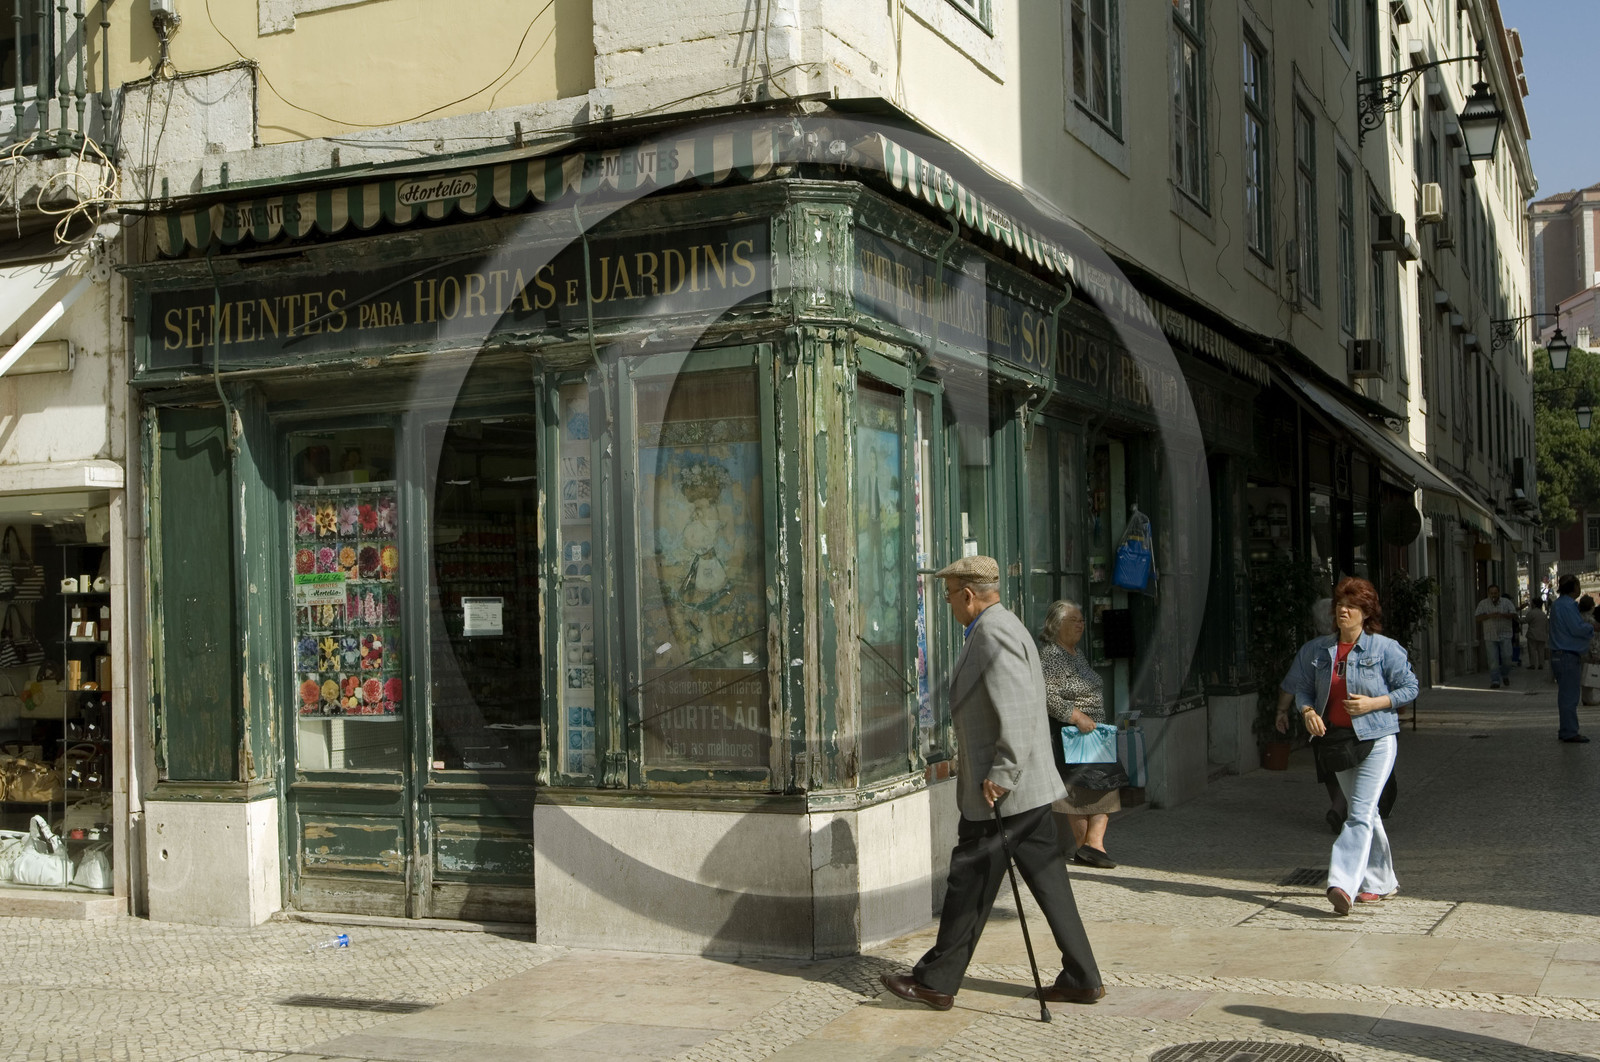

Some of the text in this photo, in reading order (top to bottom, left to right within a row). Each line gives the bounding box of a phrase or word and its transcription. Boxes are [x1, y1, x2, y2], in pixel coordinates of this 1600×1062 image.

[582, 148, 679, 179] SEMENTES
[222, 202, 302, 229] SEMENTES
[163, 239, 756, 351] SEMENTES PARA HORTAS E JARDINS
[860, 248, 913, 310] SEMENTES
[982, 299, 1011, 348] FLORES
[1021, 311, 1099, 388] SOARES
[669, 678, 713, 695] sementes
[730, 680, 762, 695] marca
[691, 743, 704, 755] as
[707, 738, 754, 758] melhores
